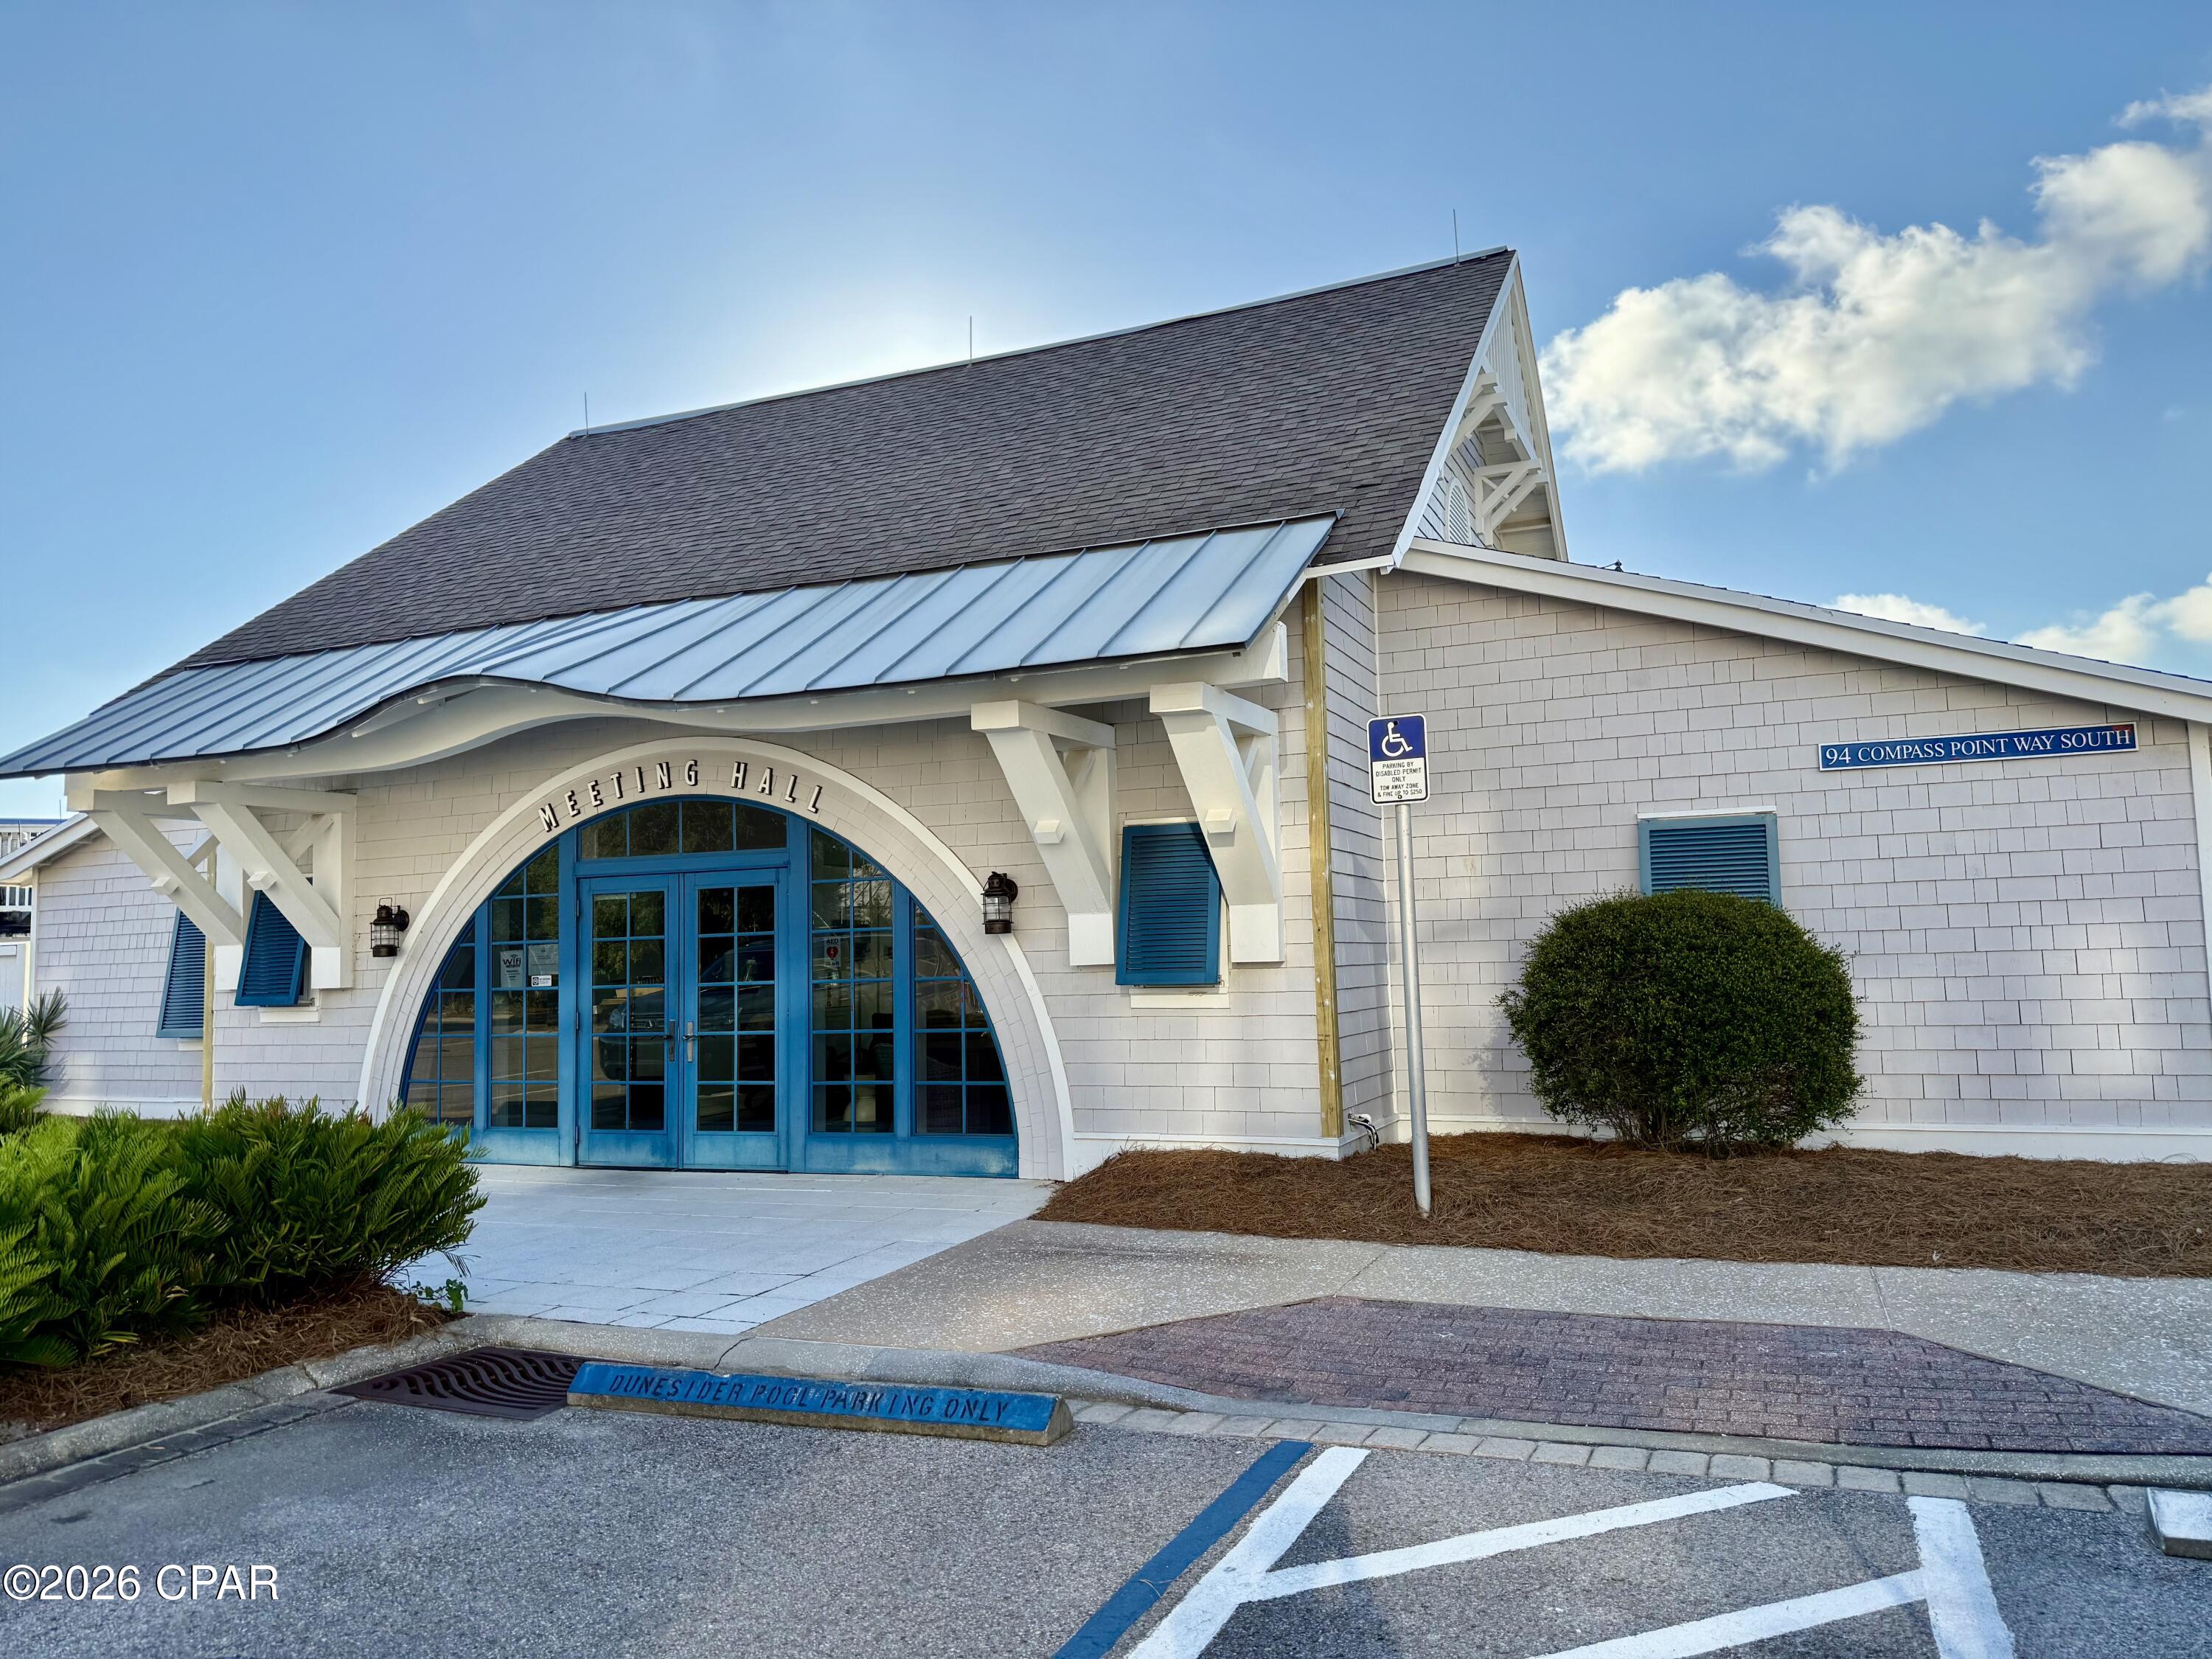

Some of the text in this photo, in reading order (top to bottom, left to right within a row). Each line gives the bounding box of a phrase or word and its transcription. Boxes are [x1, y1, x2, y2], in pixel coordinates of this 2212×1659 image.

[1826, 729, 2131, 765] 94 COMPASS POINT WAY SOUTH
[538, 759, 823, 832] MEETING HALL
[609, 1374, 1009, 1422] DUNESIDER POOL PARKING ONLY
